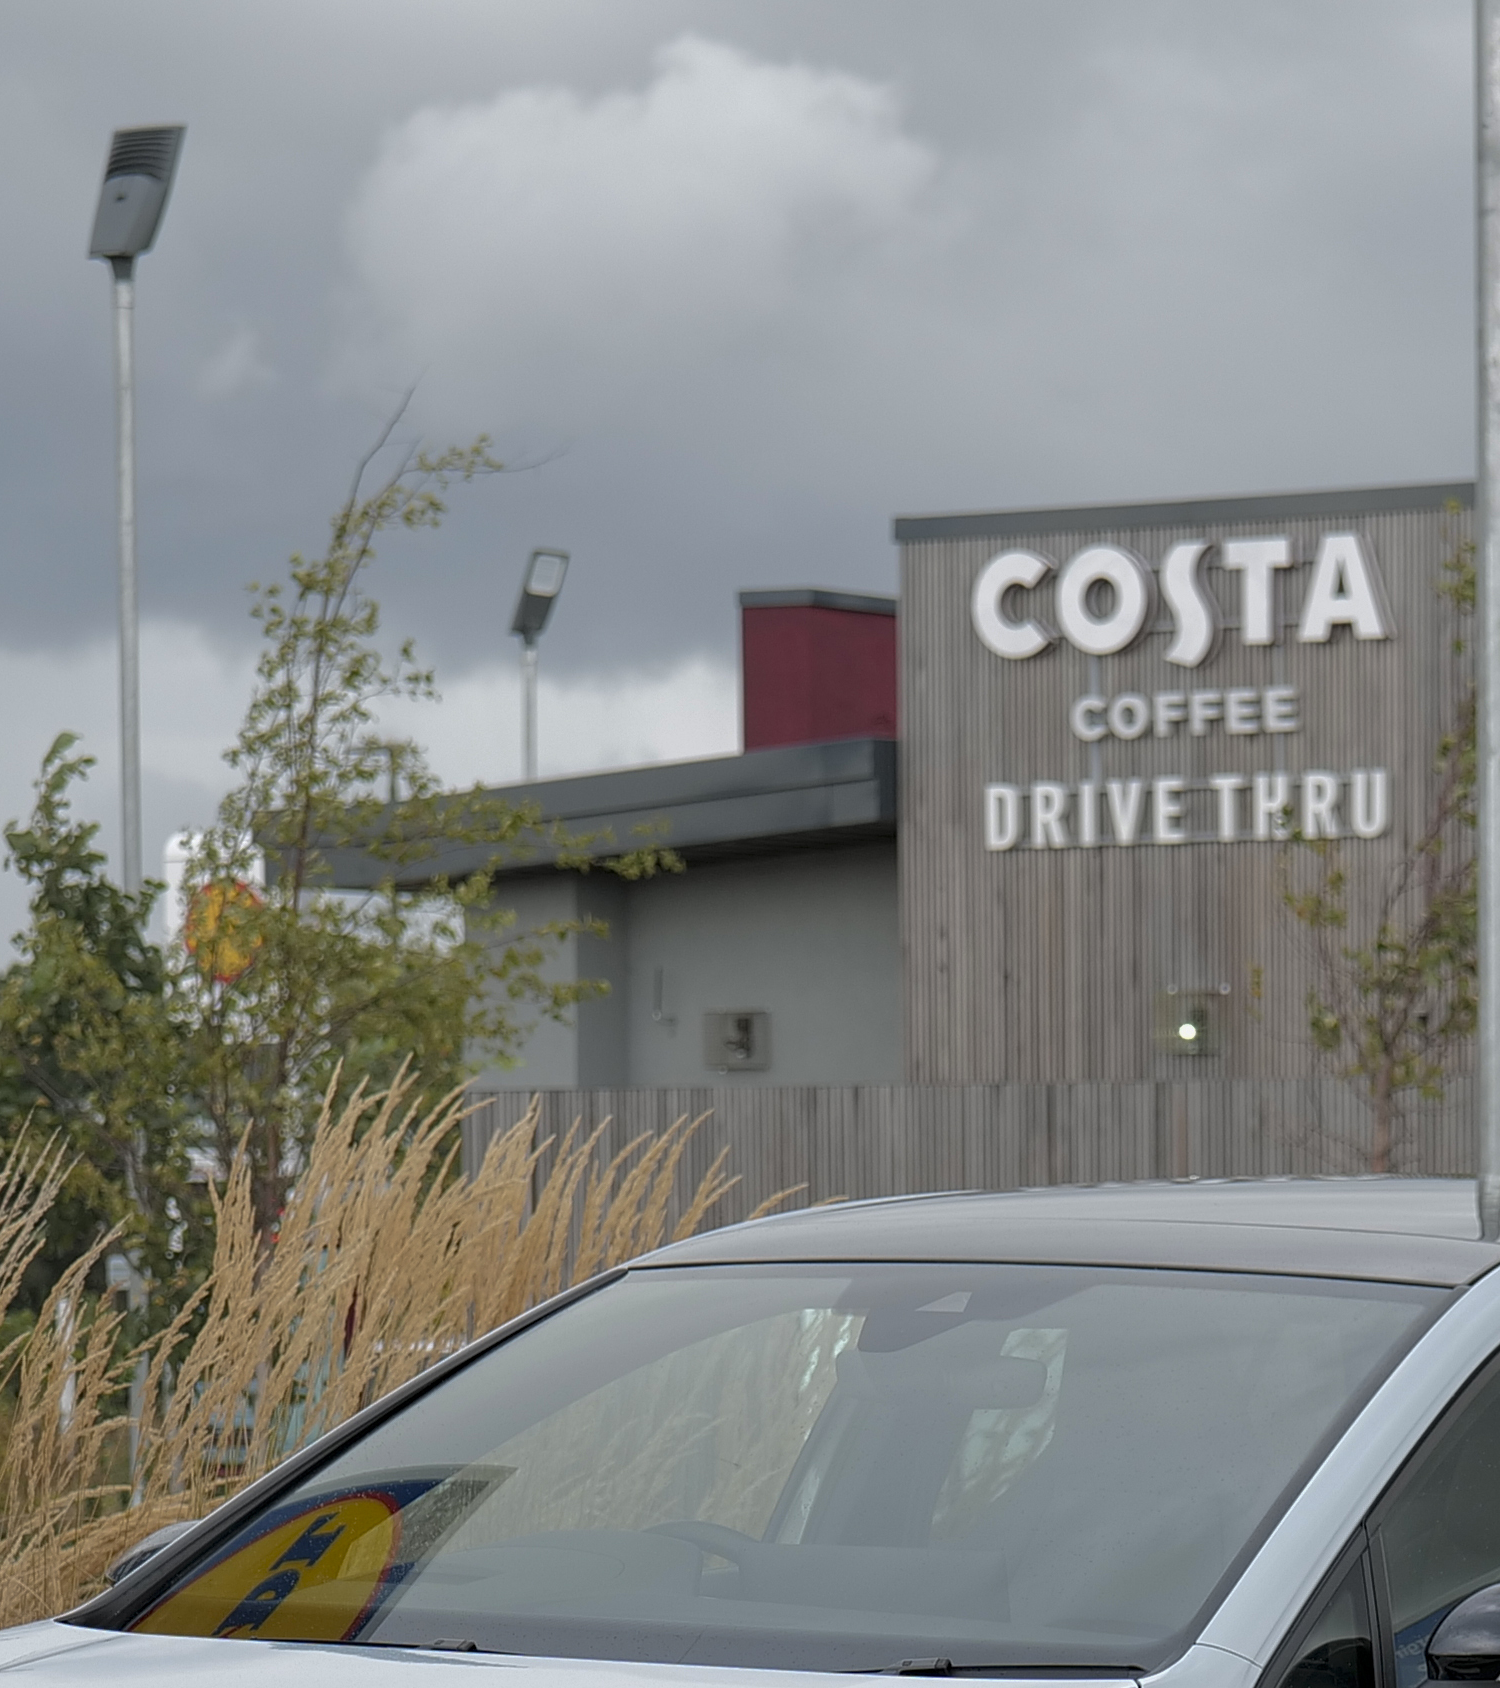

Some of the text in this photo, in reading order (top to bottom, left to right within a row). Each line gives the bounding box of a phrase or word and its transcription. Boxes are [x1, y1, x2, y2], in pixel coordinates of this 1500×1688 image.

[972, 531, 1392, 668] COSTA
[1071, 686, 1299, 741] COFFEE
[985, 768, 1388, 851] DRIVE THRU
